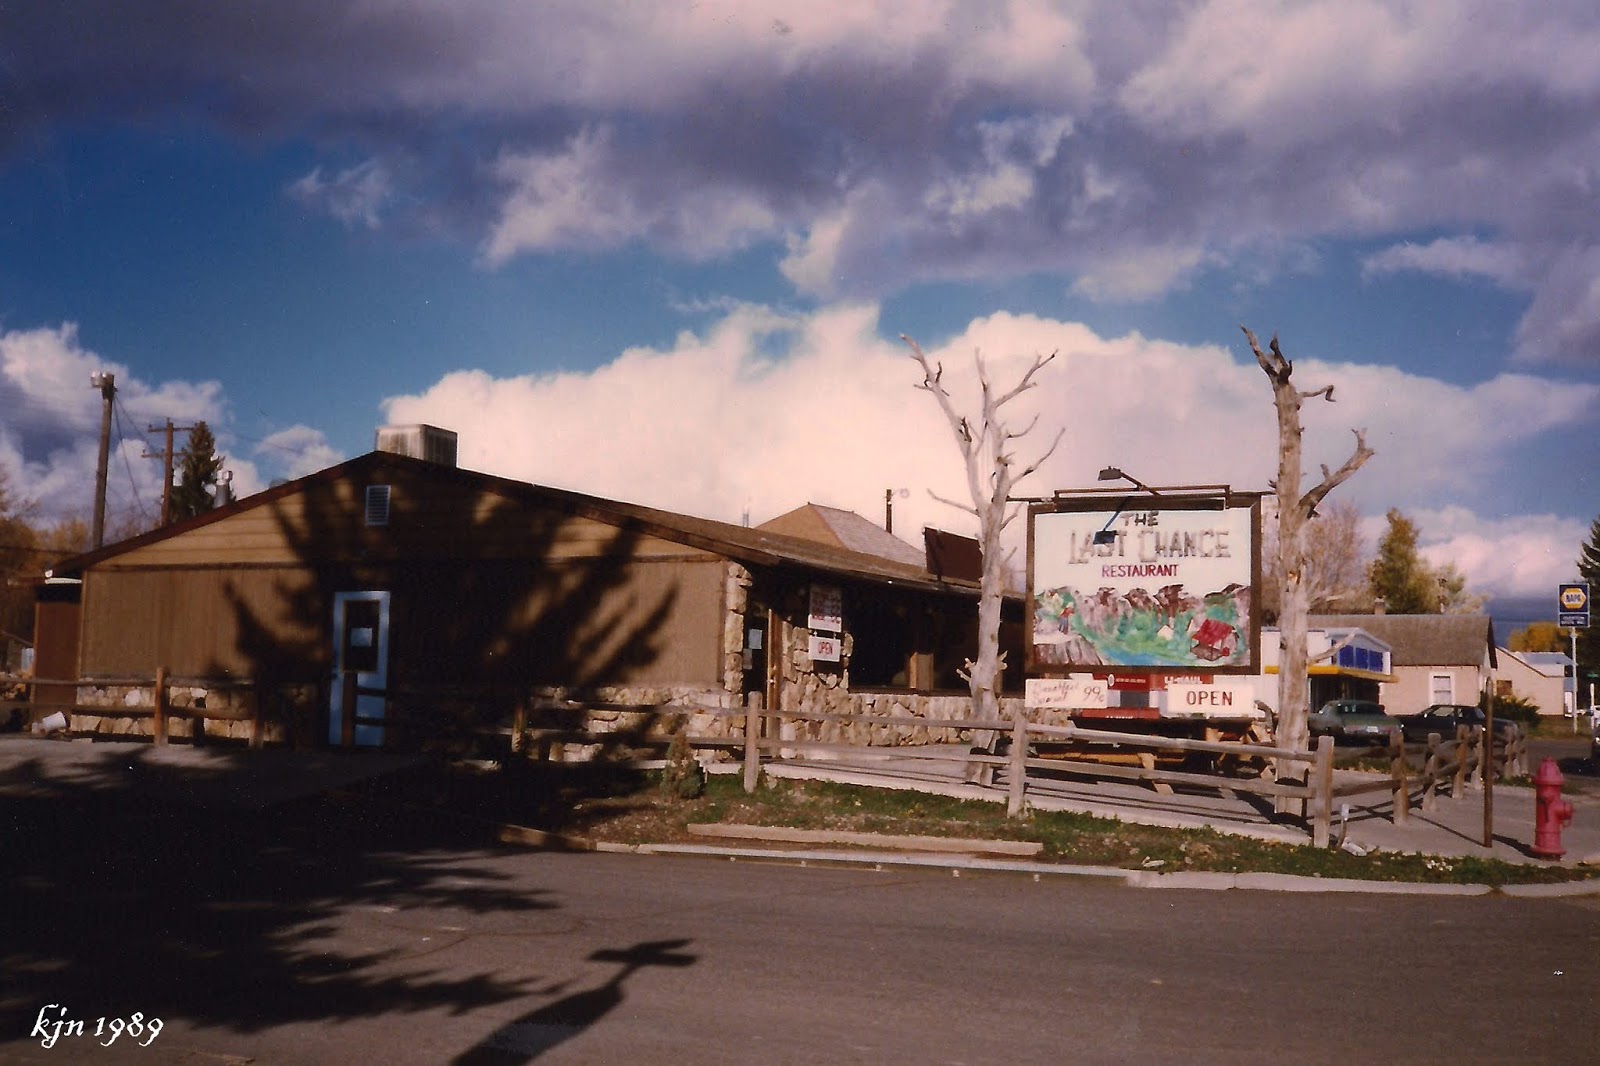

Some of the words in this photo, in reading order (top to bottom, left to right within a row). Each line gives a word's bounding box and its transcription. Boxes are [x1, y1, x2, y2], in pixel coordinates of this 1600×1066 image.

[1120, 510, 1160, 527] THE
[1138, 529, 1231, 563] CHANCE
[1101, 564, 1179, 578] RESTAURANT
[1186, 690, 1234, 706] OPEN
